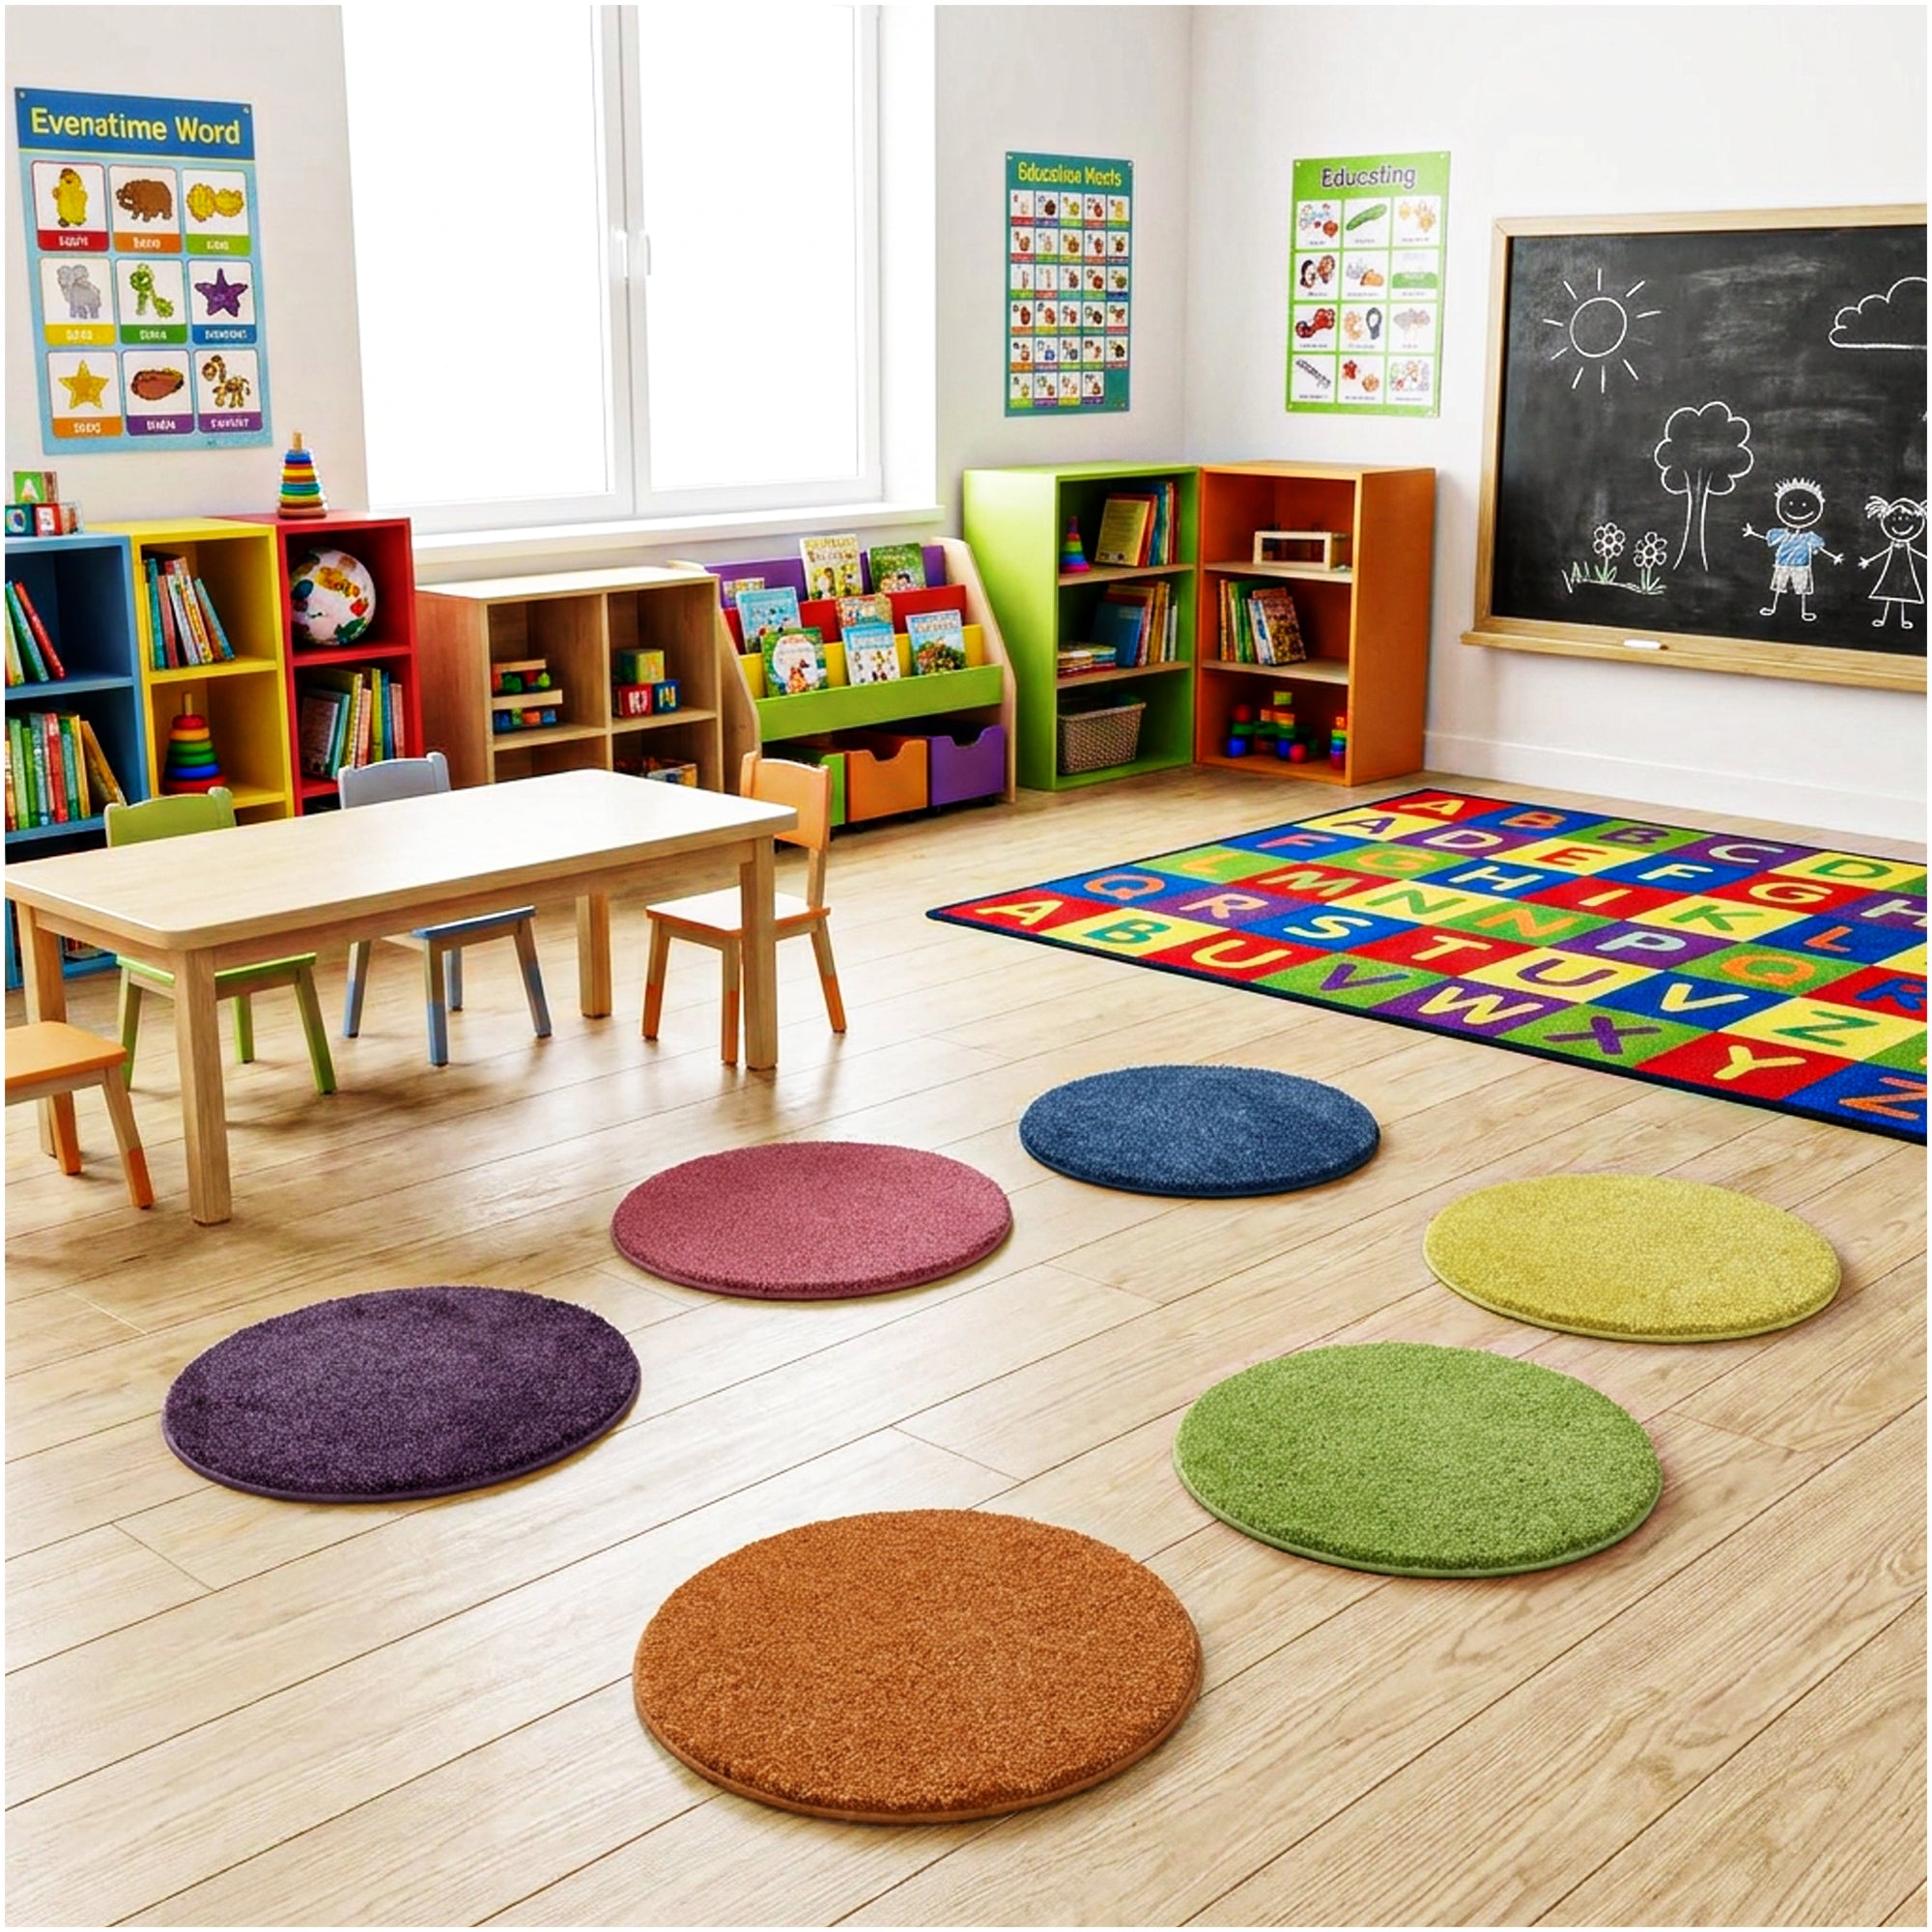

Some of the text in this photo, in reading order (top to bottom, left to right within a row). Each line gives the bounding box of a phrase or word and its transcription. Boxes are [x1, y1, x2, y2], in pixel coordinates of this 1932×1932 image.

[30, 106, 242, 145] Evenatime Word
[1321, 165, 1416, 189] Educsting
[1331, 816, 1396, 835] A
[1423, 829, 1503, 848] D
[1535, 846, 1608, 867] E
[1637, 864, 1714, 880] F
[1748, 882, 1833, 903] G
[1398, 799, 1892, 878] A B B C D
[1257, 833, 1853, 952] F G H I K L
[1257, 870, 1361, 897] M
[1365, 889, 1466, 916] N
[1473, 908, 1577, 937] N
[1595, 931, 1687, 952] P
[1720, 954, 1815, 986] Q
[975, 898, 1064, 925] A
[1082, 918, 1172, 945] B
[1191, 939, 1293, 968] U
[1320, 962, 1410, 992] V
[1417, 985, 1545, 1025] W
[1542, 1015, 1662, 1056] X
[1713, 1044, 1806, 1081] Y
[1083, 873, 1880, 1047] Q R S T U V Z
